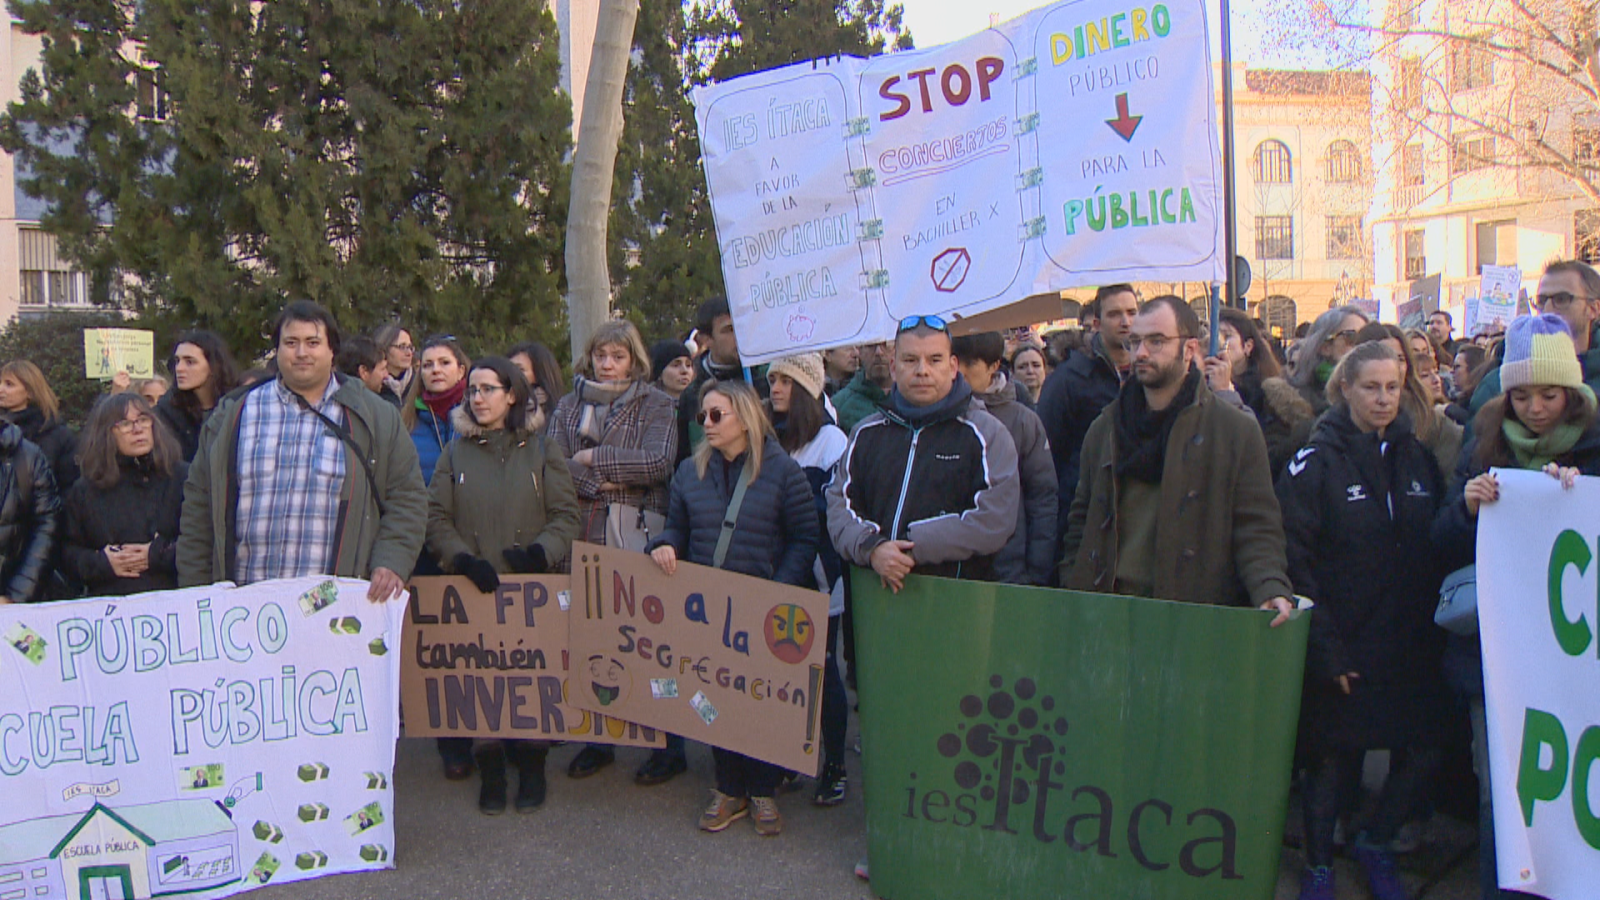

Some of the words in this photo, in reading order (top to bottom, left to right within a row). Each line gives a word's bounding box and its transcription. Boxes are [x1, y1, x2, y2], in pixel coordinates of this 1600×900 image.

[1049, 3, 1170, 67] DINERO
[879, 56, 1004, 121] STOP
[1069, 56, 1159, 96] PÚBLICO
[723, 113, 758, 152] IES
[767, 98, 831, 140] ÍTACA
[879, 116, 1007, 173] CONCIERTOS
[755, 174, 800, 196] FAVOR
[770, 157, 780, 170] A
[1081, 154, 1128, 178] PARA
[1142, 148, 1166, 168] LA
[763, 201, 776, 215] DE
[782, 195, 798, 210] LA
[936, 191, 955, 216] EN
[1063, 185, 1196, 235] PÚBLICA
[731, 203, 850, 268] EDUCACIÓN
[750, 266, 838, 312] PÚBLICA
[410, 584, 469, 624] LA
[495, 581, 548, 627] FP
[1548, 528, 1600, 661] C
[57, 598, 288, 681] PÚBLICO
[685, 593, 709, 625] a
[722, 596, 750, 656] la
[416, 630, 546, 671] también
[170, 665, 368, 755] PÚBLICA
[903, 772, 977, 828] ies
[63, 845, 101, 859] ESCUELA
[105, 837, 139, 853] PÚBLICA
